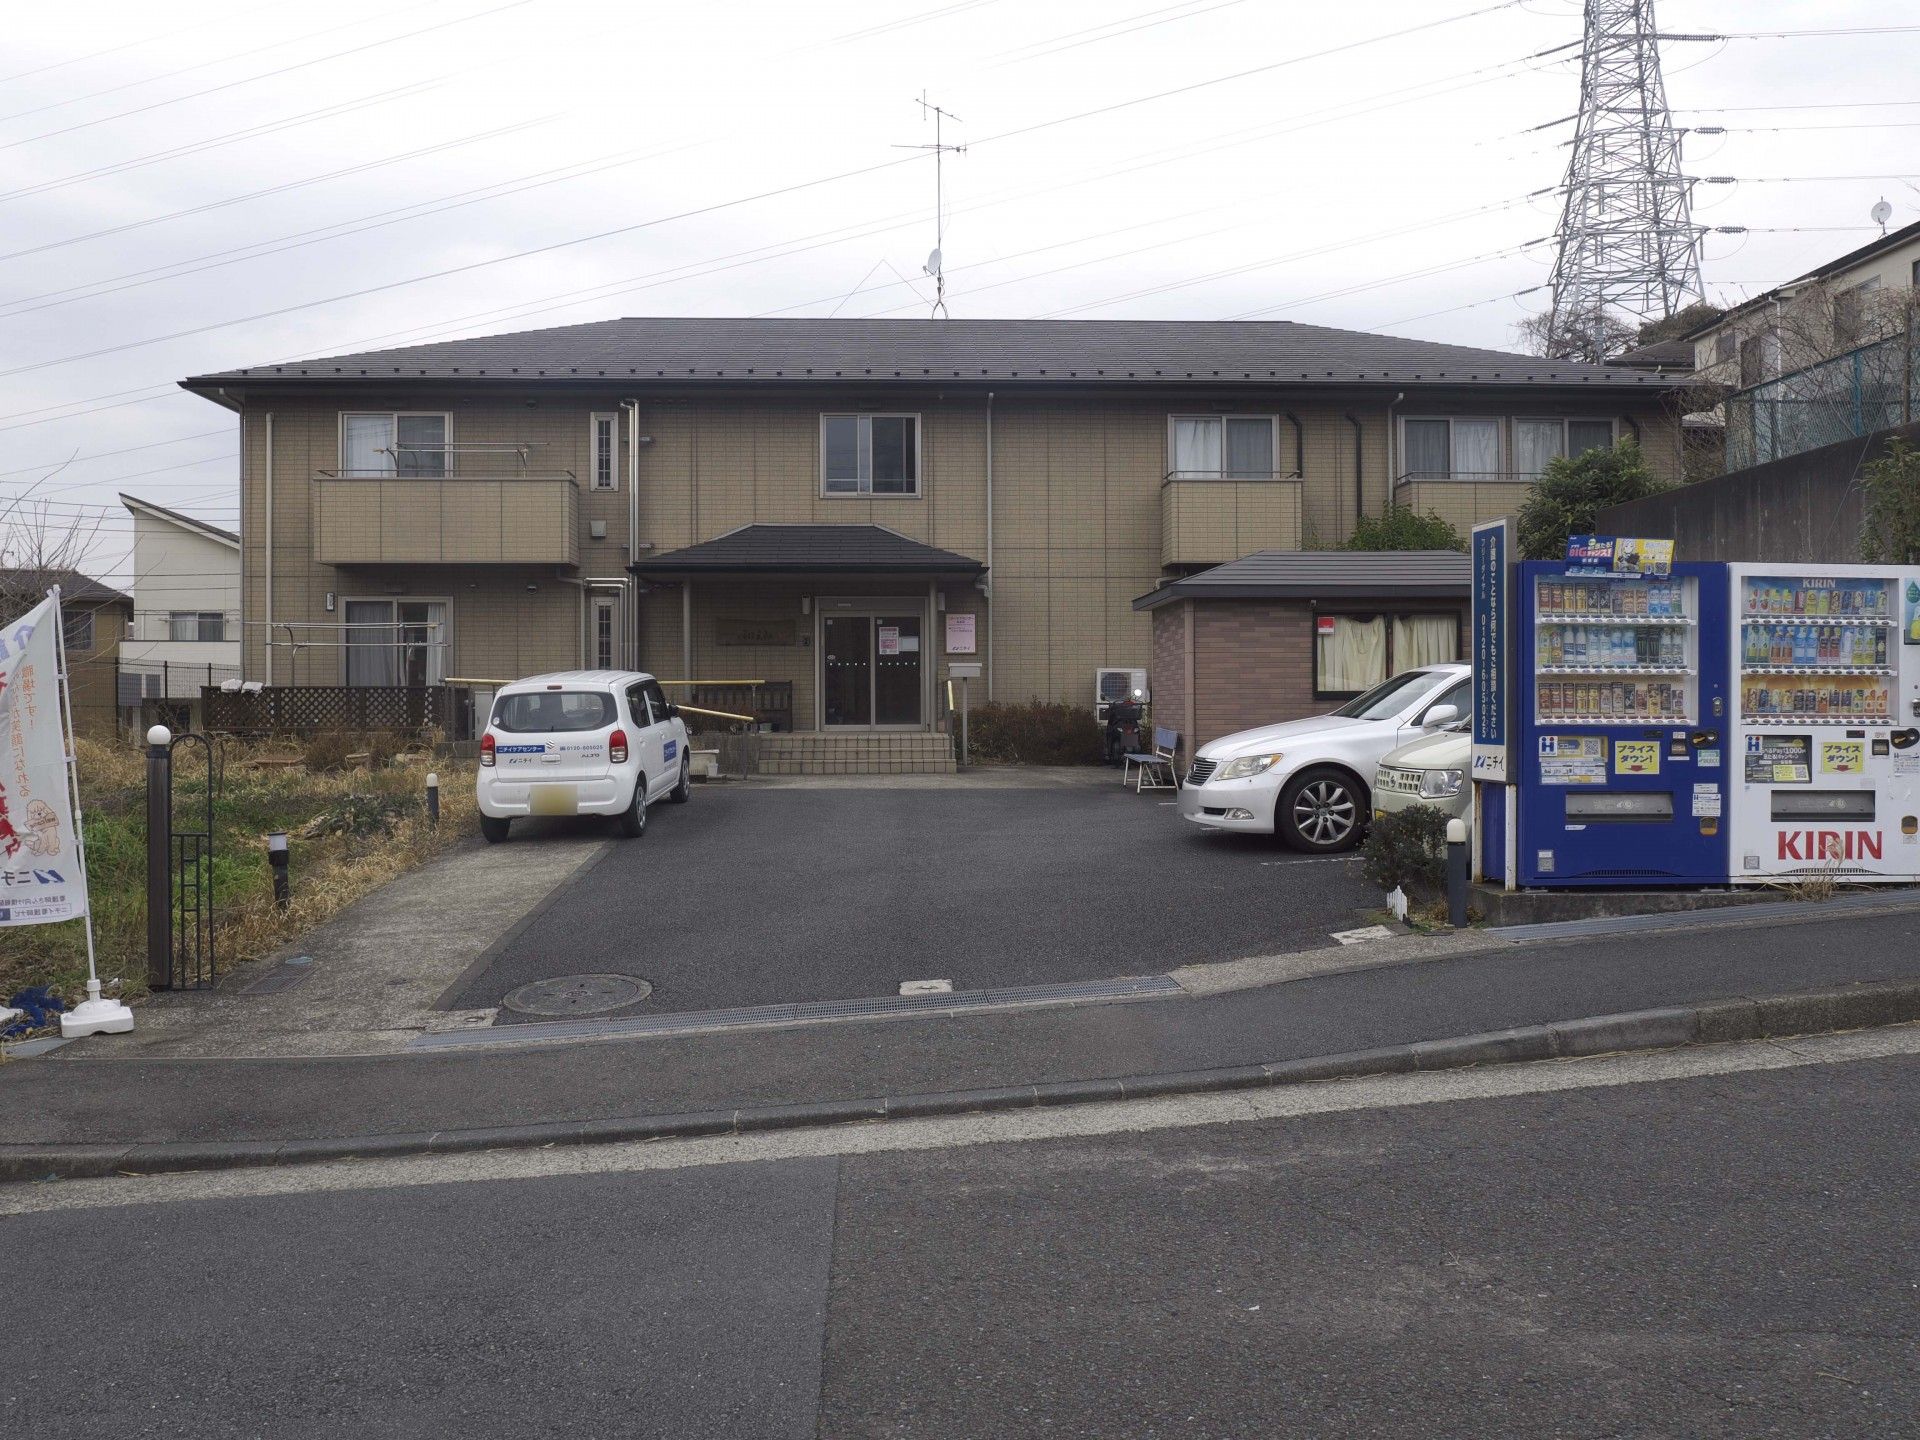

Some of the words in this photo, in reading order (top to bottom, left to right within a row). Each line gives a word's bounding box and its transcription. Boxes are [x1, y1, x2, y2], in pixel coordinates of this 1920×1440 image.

[1802, 579, 1836, 588] KIRIN
[1617, 744, 1655, 753] プライス
[1824, 745, 1861, 753] プライス
[1487, 755, 1504, 771] ニチイ
[1621, 754, 1653, 763] ダウン!
[1827, 754, 1858, 763] ダウン!
[1777, 831, 1883, 860] KIRIN
